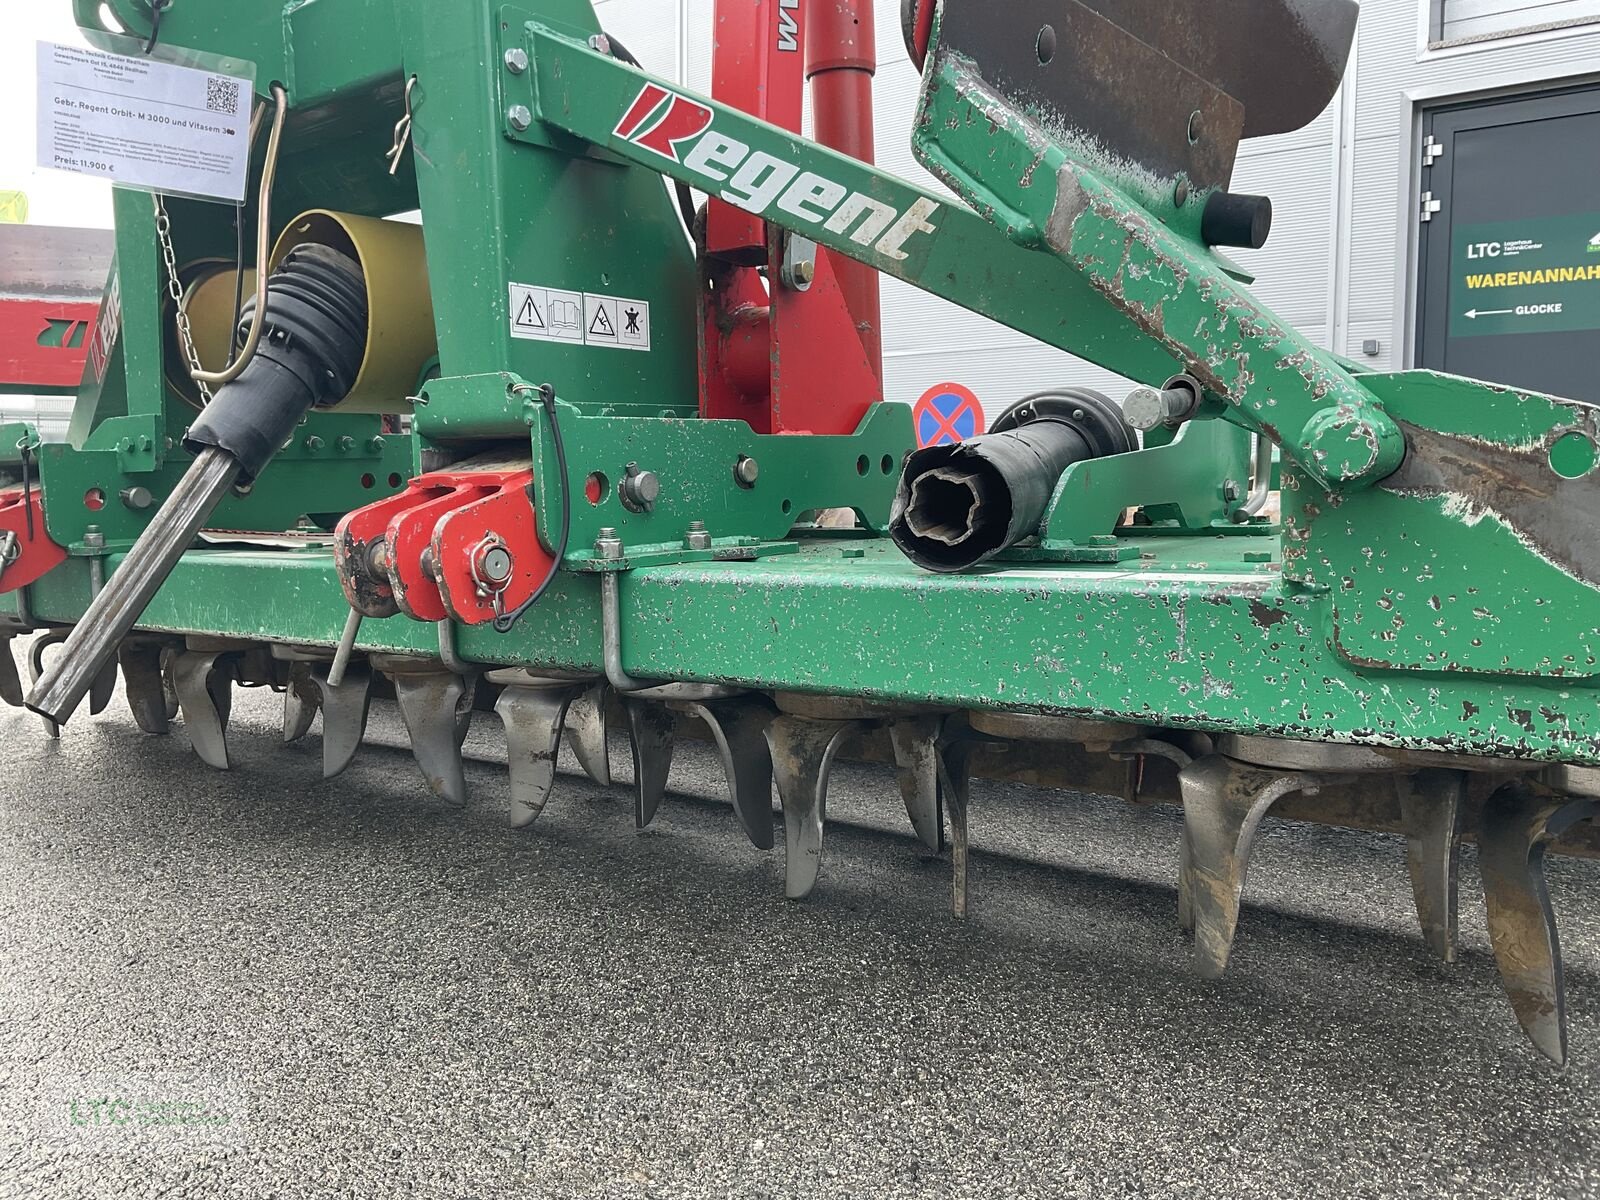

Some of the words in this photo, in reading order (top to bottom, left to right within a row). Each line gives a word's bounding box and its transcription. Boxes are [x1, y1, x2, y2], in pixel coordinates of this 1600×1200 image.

[54, 96, 78, 108] Gebr.
[79, 101, 109, 114] Regent
[111, 107, 136, 118] Orbit-
[138, 112, 146, 120] M
[147, 113, 170, 124] 3000
[172, 119, 188, 128] und
[188, 120, 220, 134] Vitasem
[54, 154, 79, 166] Preis:
[80, 159, 107, 171] 11.900
[108, 164, 116, 172] €
[612, 81, 940, 261] Regent
[1467, 241, 1501, 259] LTC
[1515, 303, 1563, 315] GLOCKE
